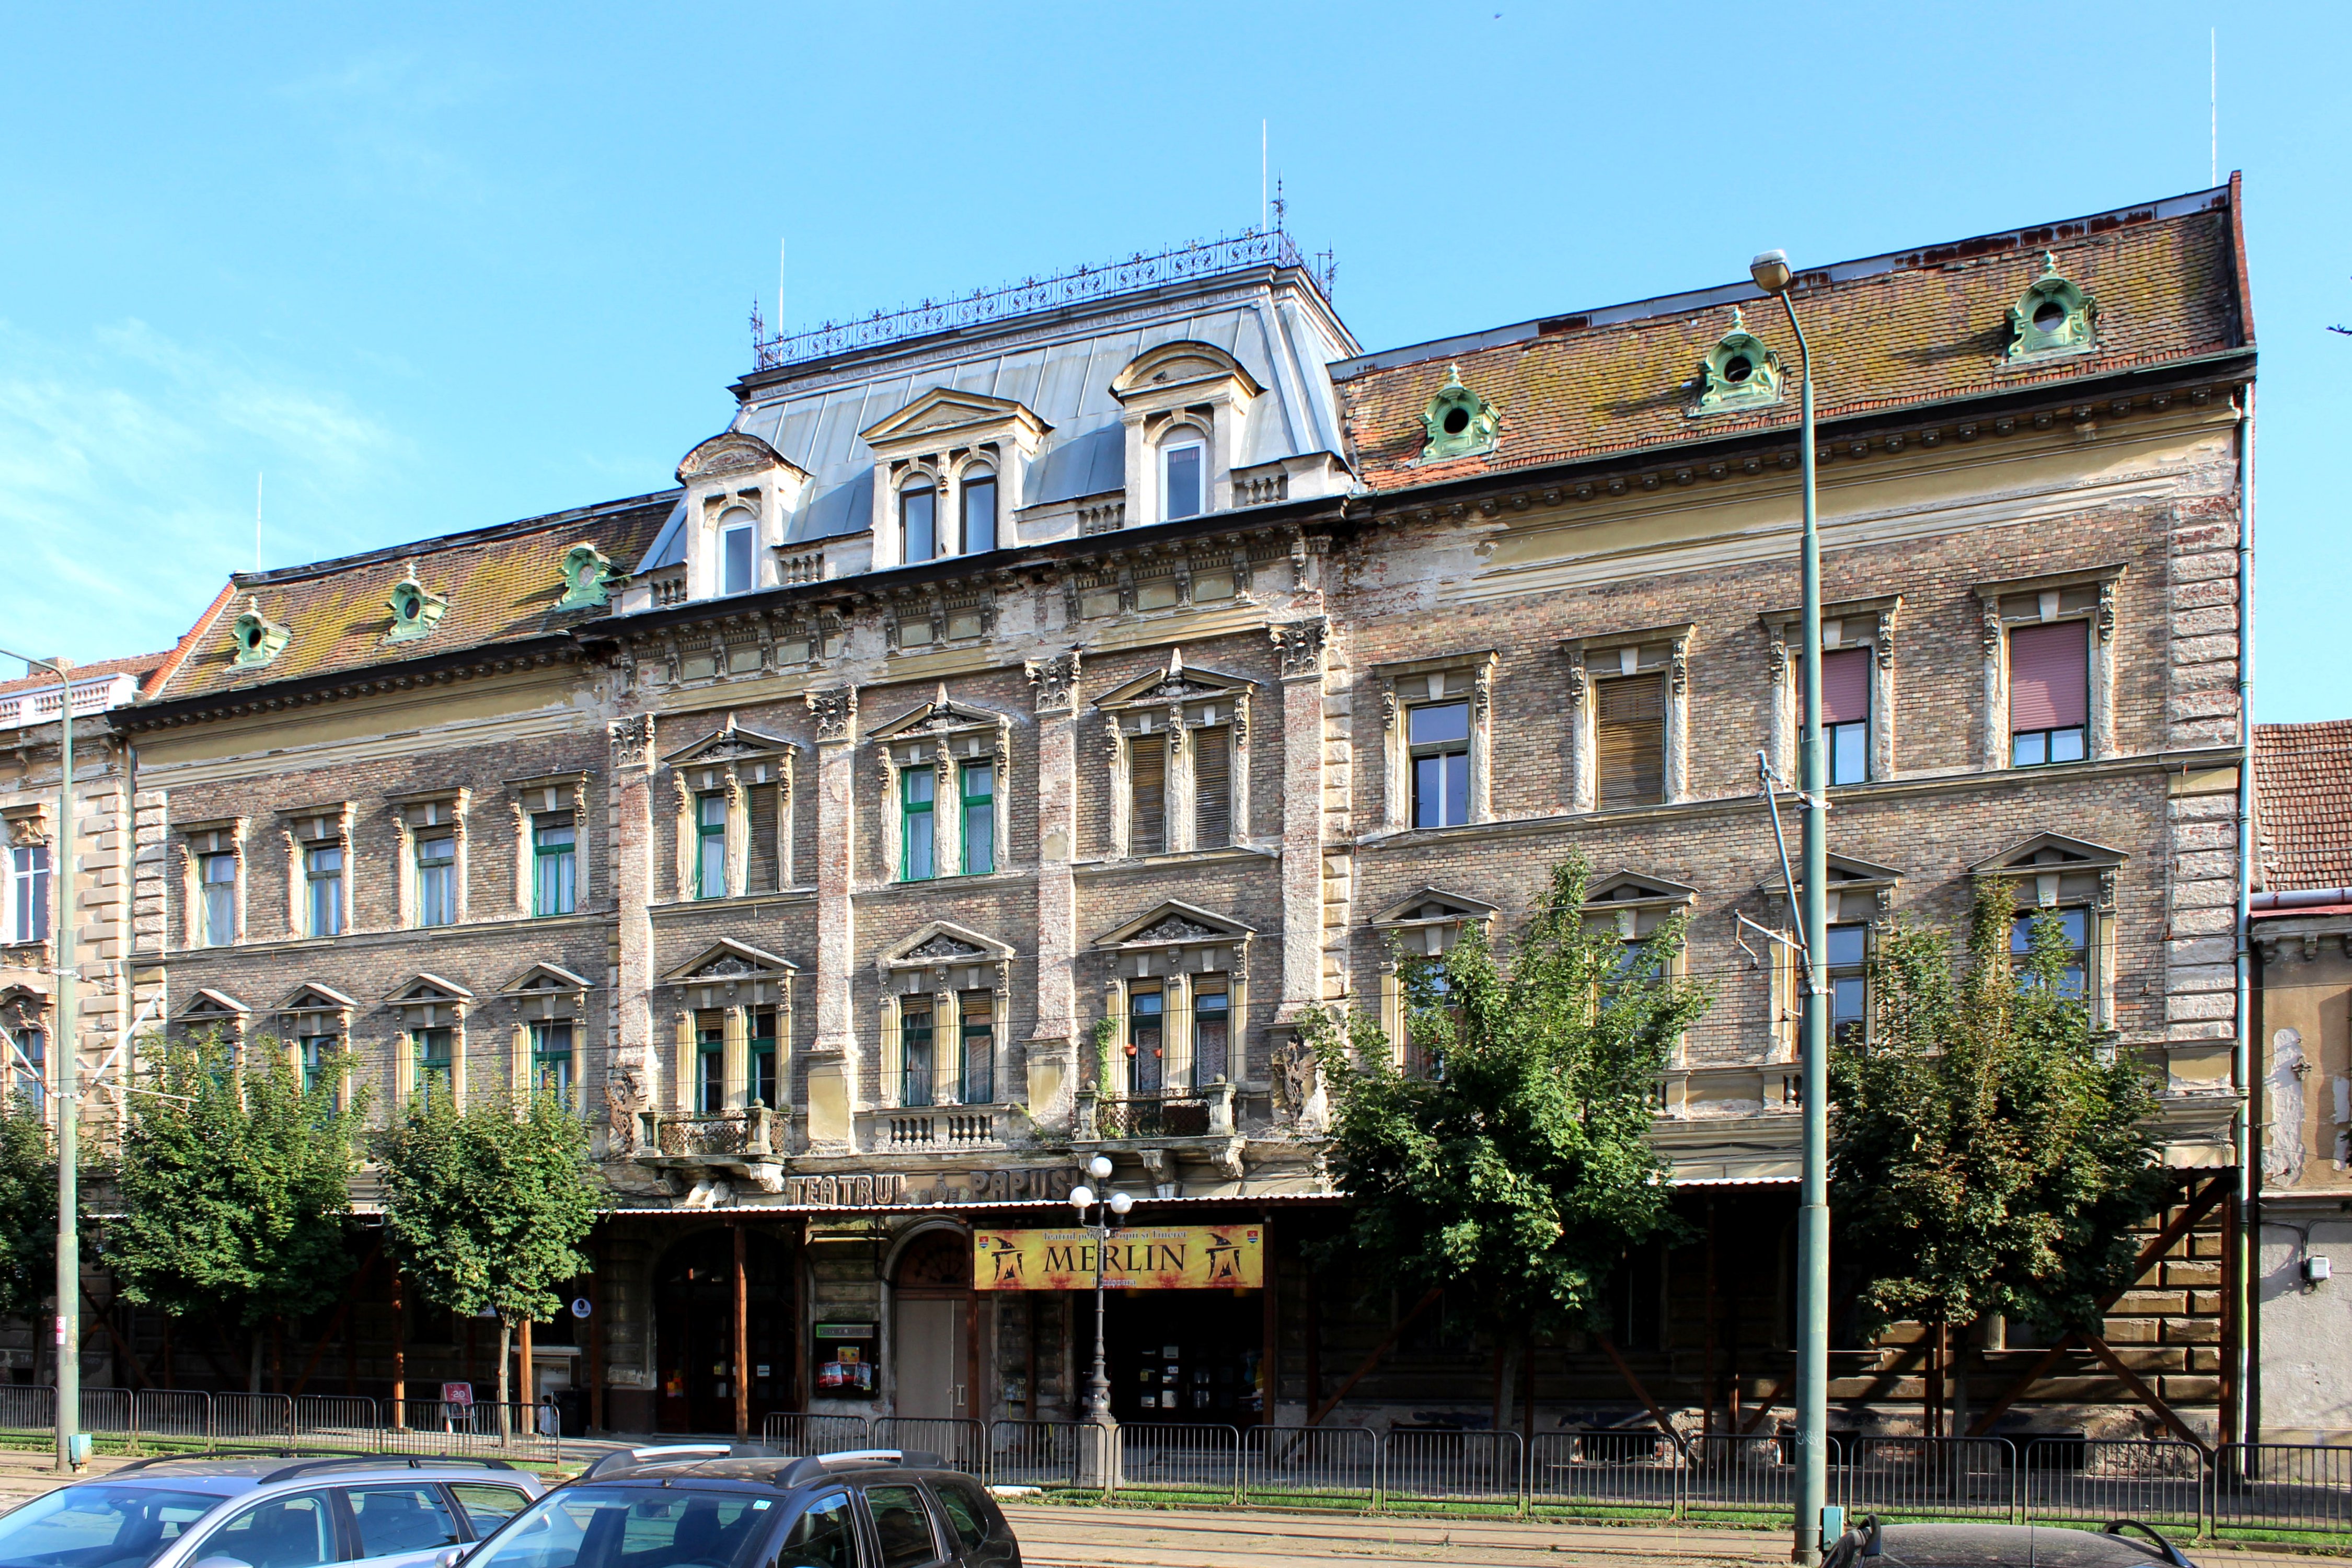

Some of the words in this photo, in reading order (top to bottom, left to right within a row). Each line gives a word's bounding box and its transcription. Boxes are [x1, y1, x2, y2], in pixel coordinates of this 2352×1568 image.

[789, 1174, 910, 1205] TEATRUL
[1044, 1231, 1076, 1240] Teatrul
[1152, 1229, 1187, 1239] Tineret
[1043, 1244, 1187, 1275] MERLIN
